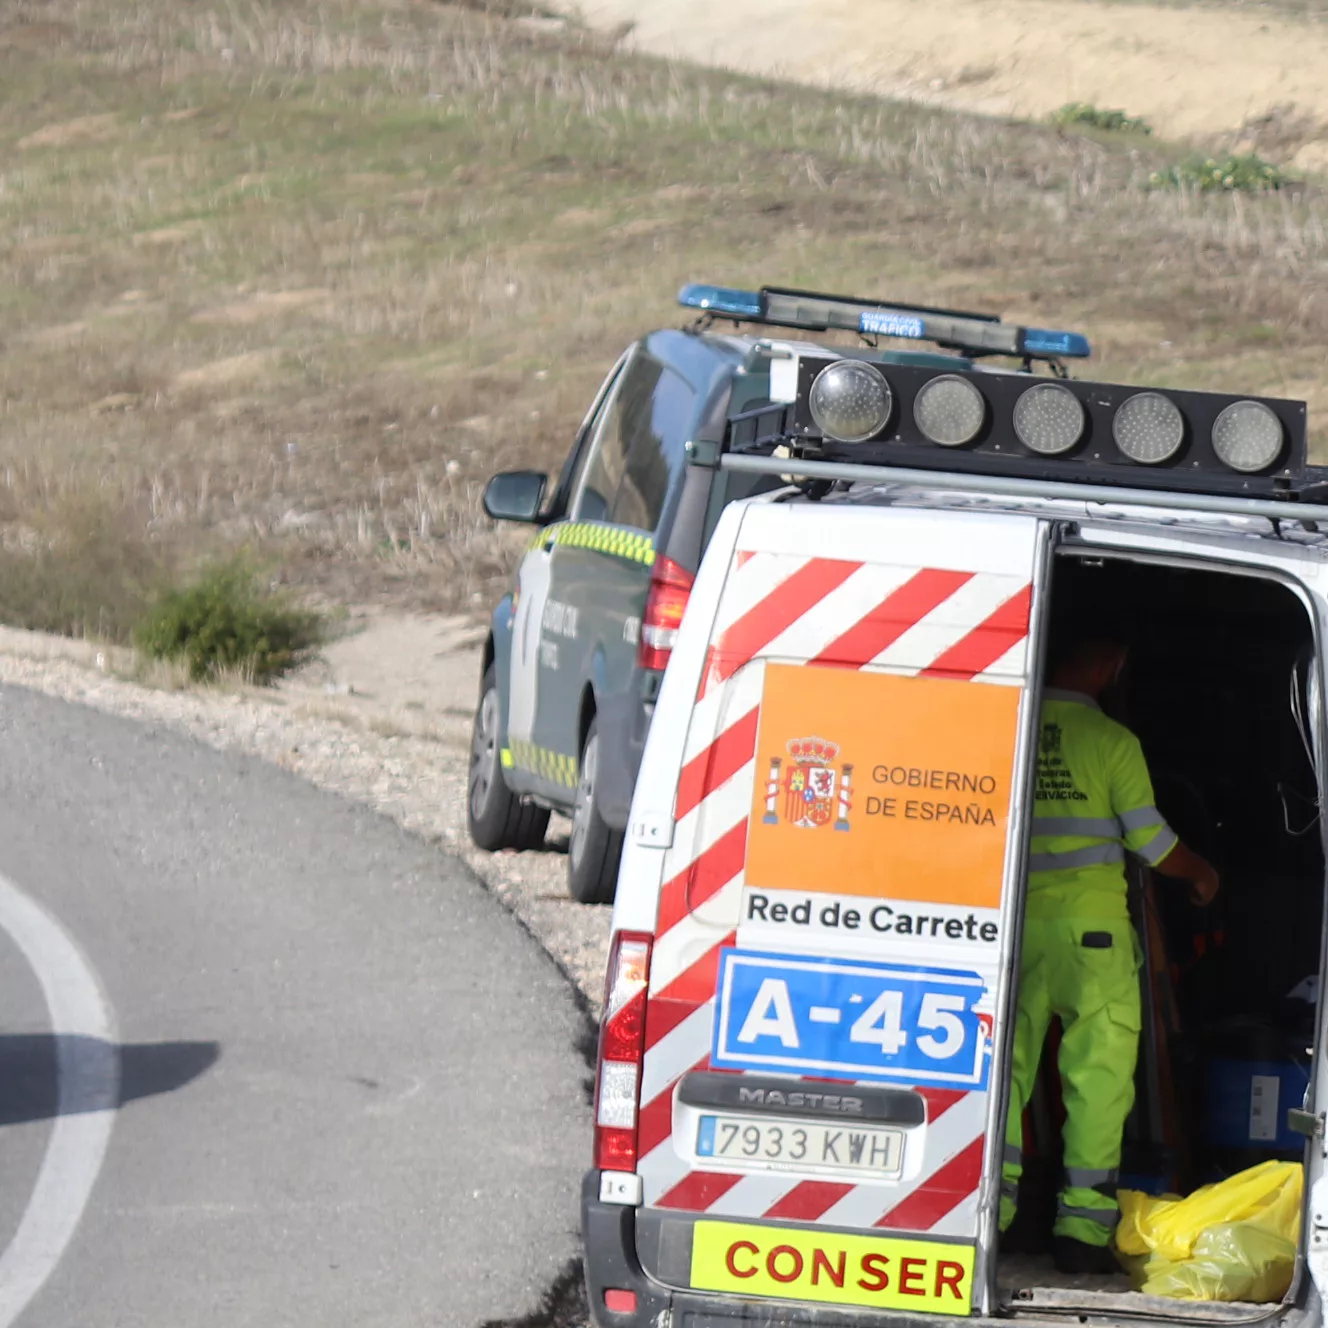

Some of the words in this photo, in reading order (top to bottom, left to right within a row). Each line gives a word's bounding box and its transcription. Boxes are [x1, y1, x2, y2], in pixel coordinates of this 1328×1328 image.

[872, 765, 996, 794] GOBIERNO
[866, 796, 897, 817] DE
[904, 801, 996, 826] ESPAÑA
[747, 894, 812, 925] Red
[819, 902, 861, 929] de
[737, 978, 965, 1059] A-45
[739, 1087, 863, 1112] MASTER
[719, 1124, 808, 1159] 7933
[822, 1130, 891, 1166] KWH
[726, 1240, 965, 1300] CONSER
